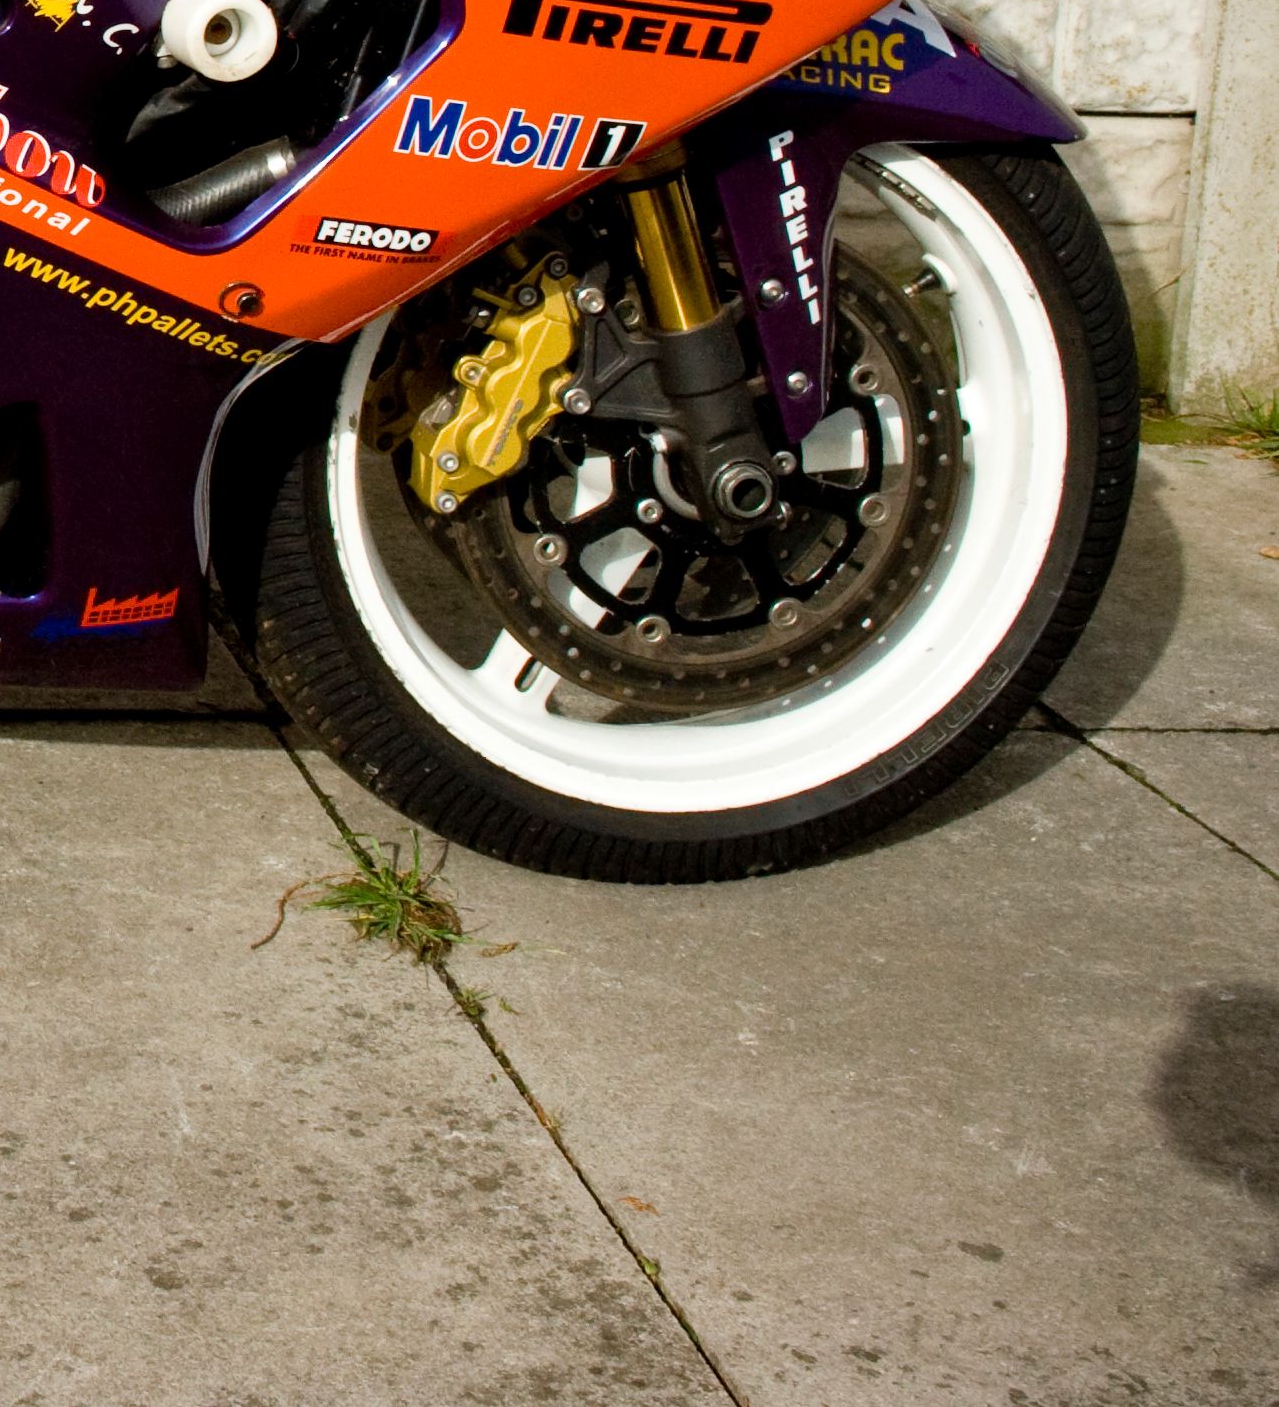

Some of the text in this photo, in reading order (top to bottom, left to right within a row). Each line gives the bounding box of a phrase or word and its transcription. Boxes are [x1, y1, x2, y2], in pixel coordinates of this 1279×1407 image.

[781, 64, 892, 94] CING
[393, 94, 585, 171] Mobil
[289, 243, 312, 254] THE
[313, 245, 346, 259] FIRST
[346, 250, 384, 263] NAME
[385, 255, 400, 264] IN
[316, 219, 432, 252] FERODO
[768, 129, 821, 325] PIRELLI
[3, 246, 291, 366] www.phpallets.co
